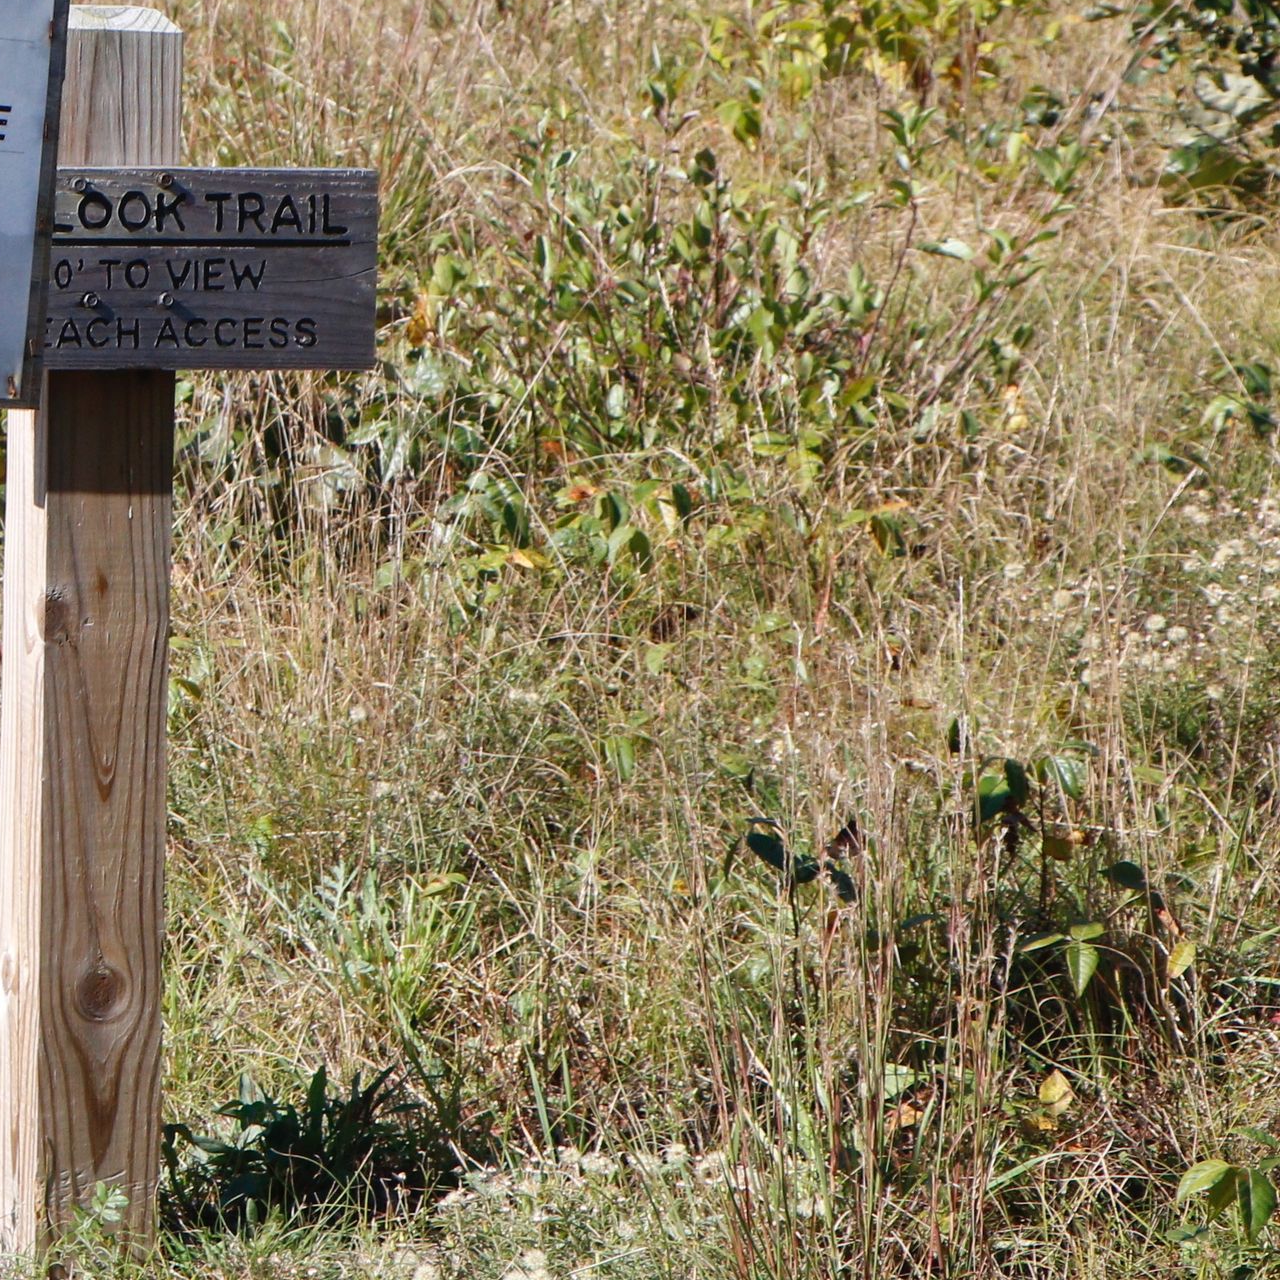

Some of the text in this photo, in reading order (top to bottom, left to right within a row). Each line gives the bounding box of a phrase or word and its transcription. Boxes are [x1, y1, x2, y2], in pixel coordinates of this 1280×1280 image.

[204, 192, 348, 235] TRAIL
[99, 259, 149, 289] TO
[166, 259, 266, 291] VIEW
[155, 318, 318, 349] ACCESS
